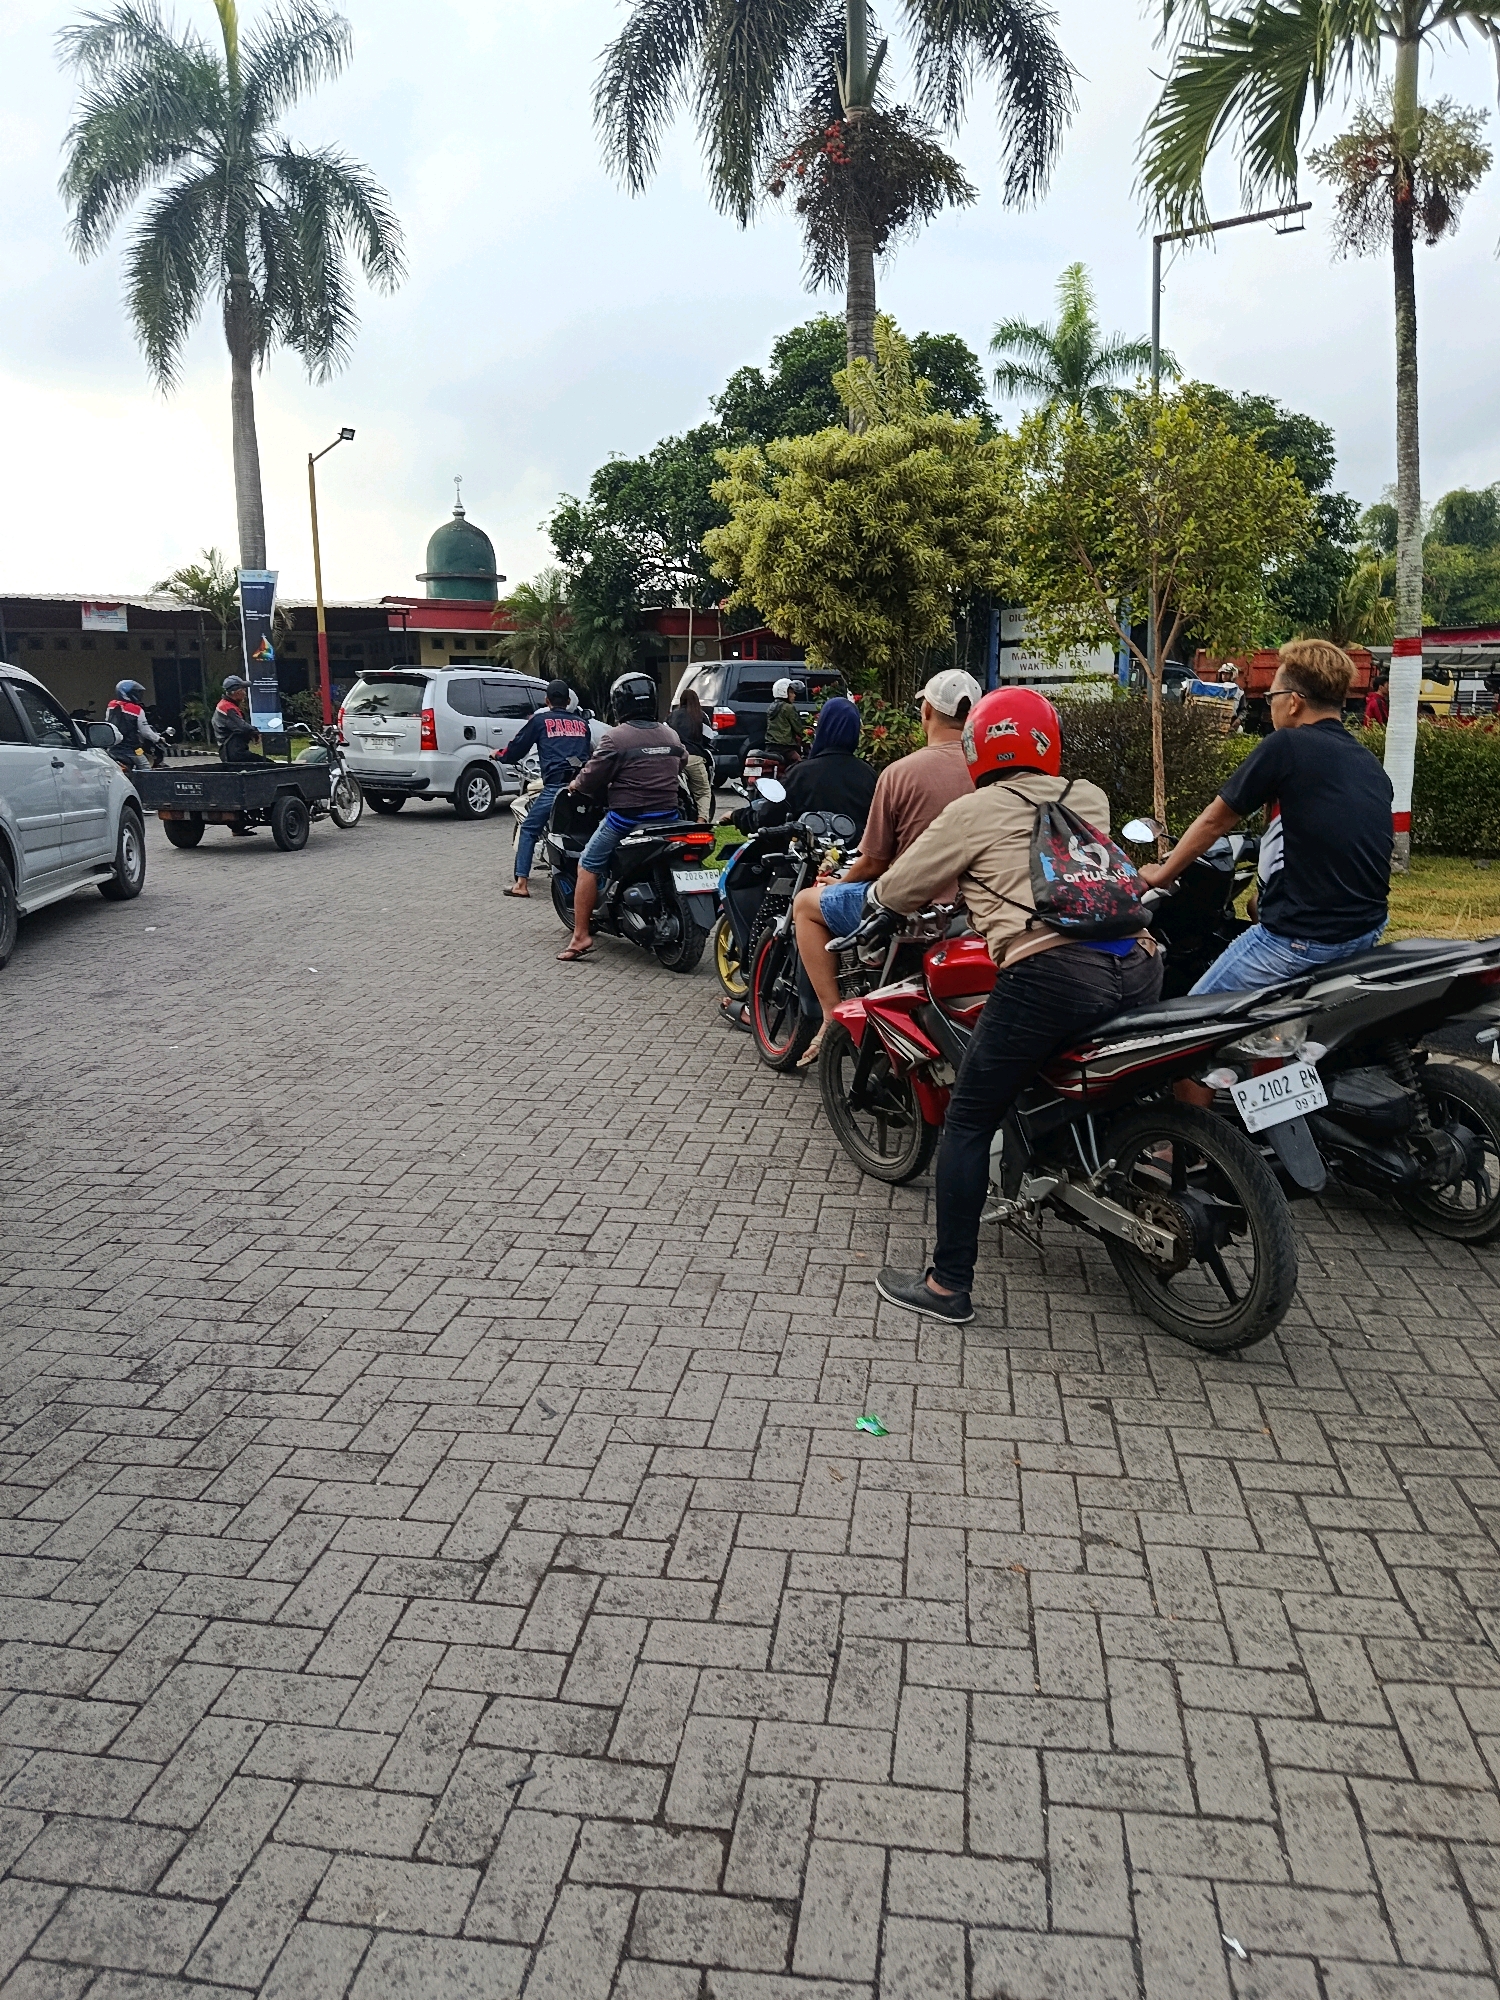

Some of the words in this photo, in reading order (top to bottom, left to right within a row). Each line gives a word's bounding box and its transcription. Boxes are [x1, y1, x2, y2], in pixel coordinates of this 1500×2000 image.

[1019, 662, 1052, 671] WAKTU
[684, 872, 704, 881] 2026
[1237, 1090, 1247, 1110] P
[1258, 1075, 1293, 1103] 2102
